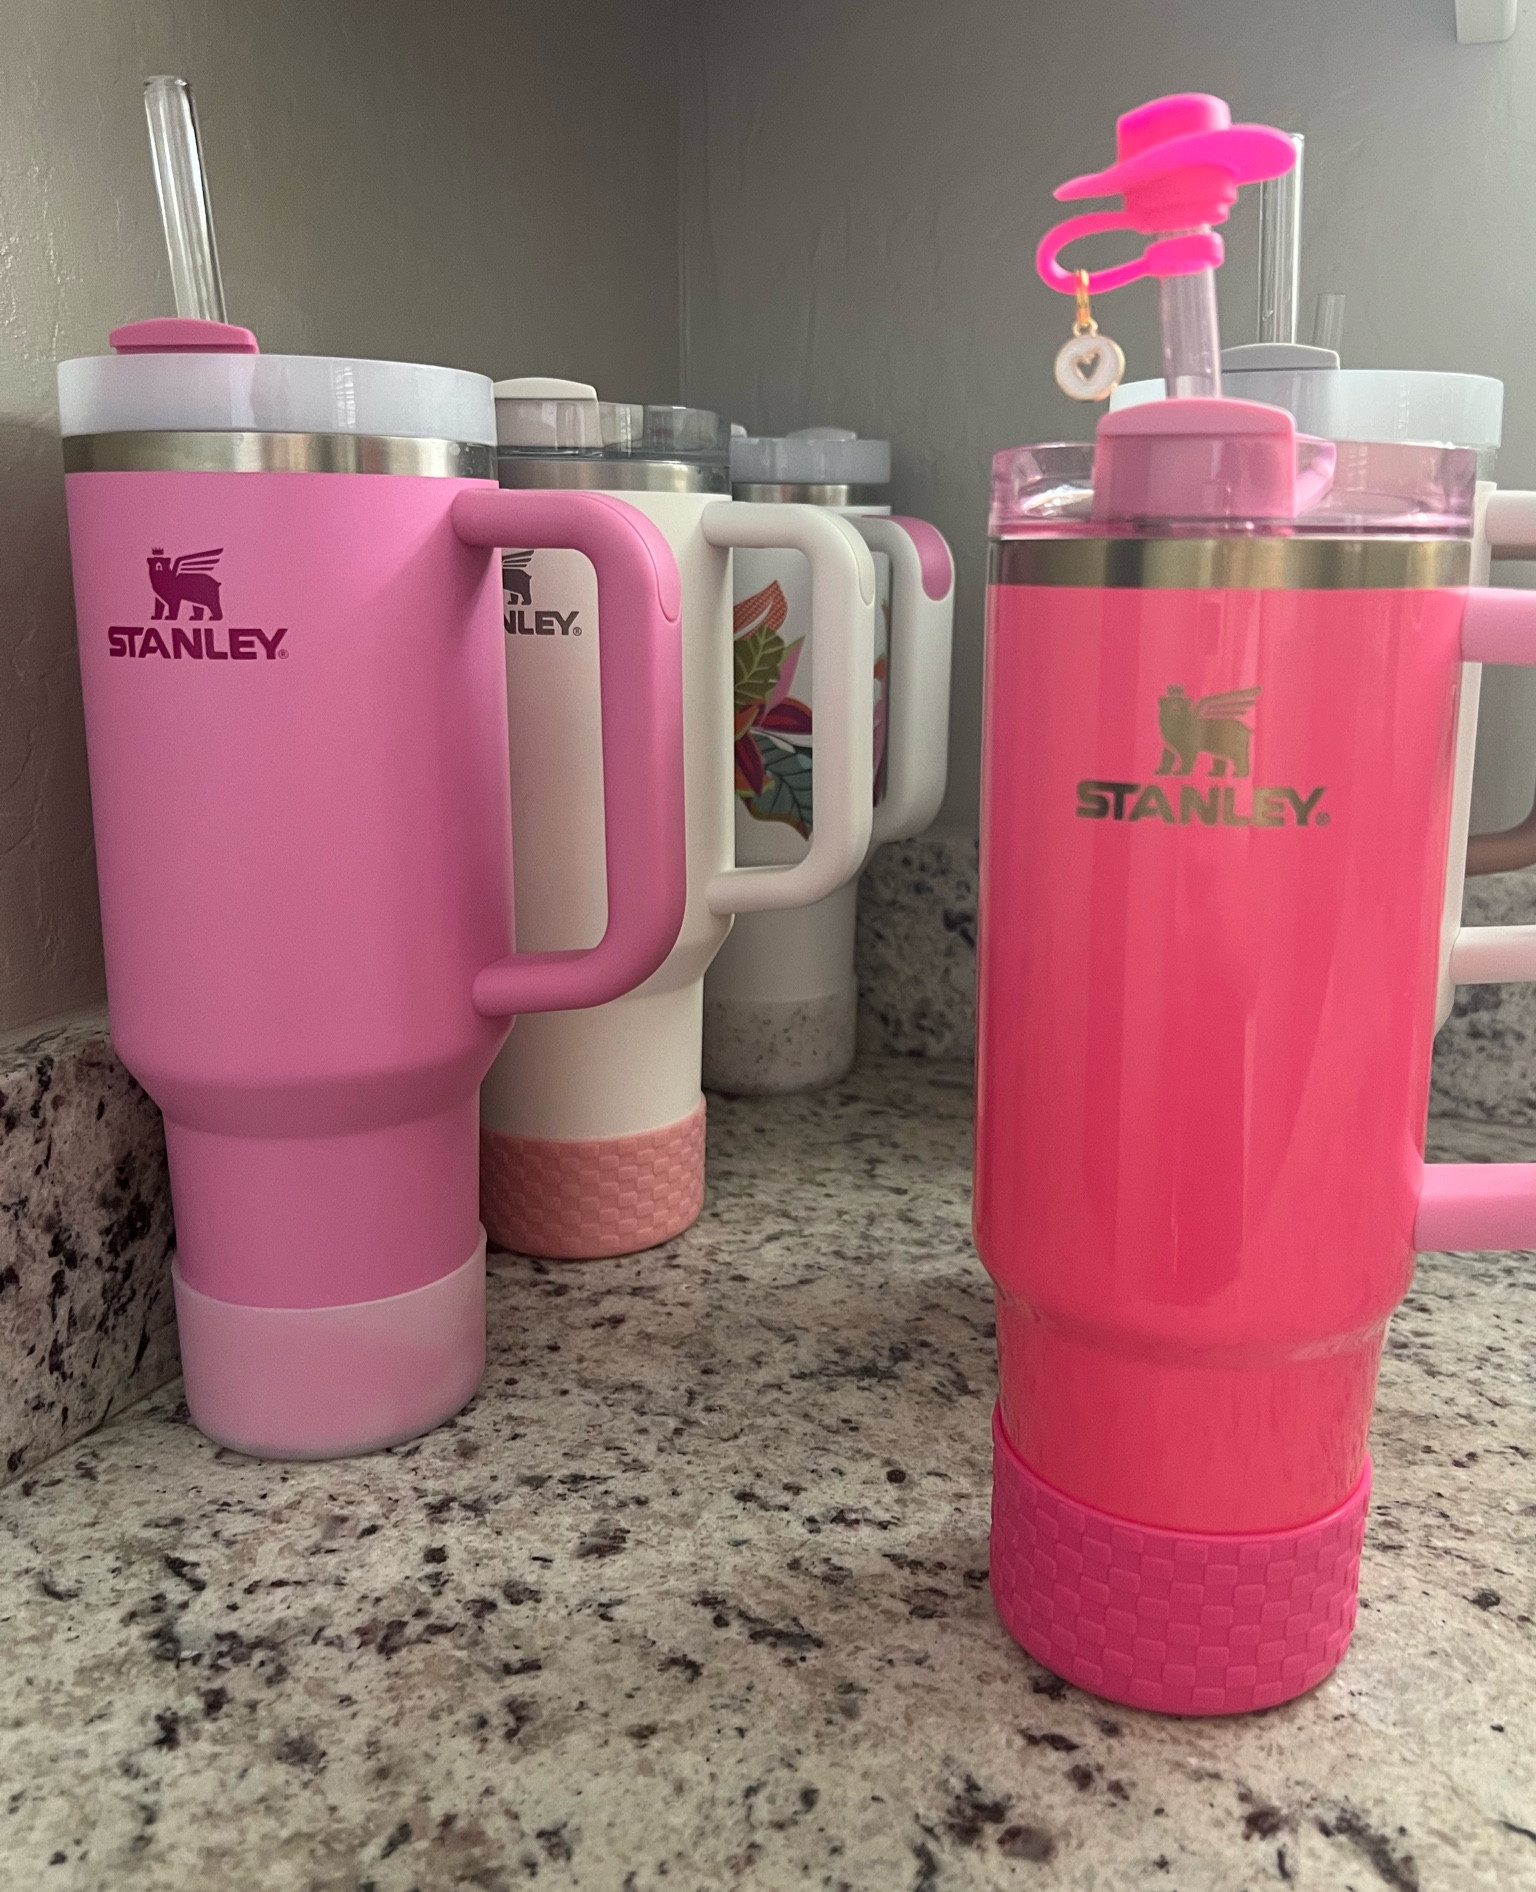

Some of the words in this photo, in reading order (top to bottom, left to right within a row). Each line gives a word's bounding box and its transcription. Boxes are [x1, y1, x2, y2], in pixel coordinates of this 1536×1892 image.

[503, 610, 579, 636] NLEY
[108, 625, 289, 661] STANLEY
[1075, 779, 1327, 828] STANLEY
